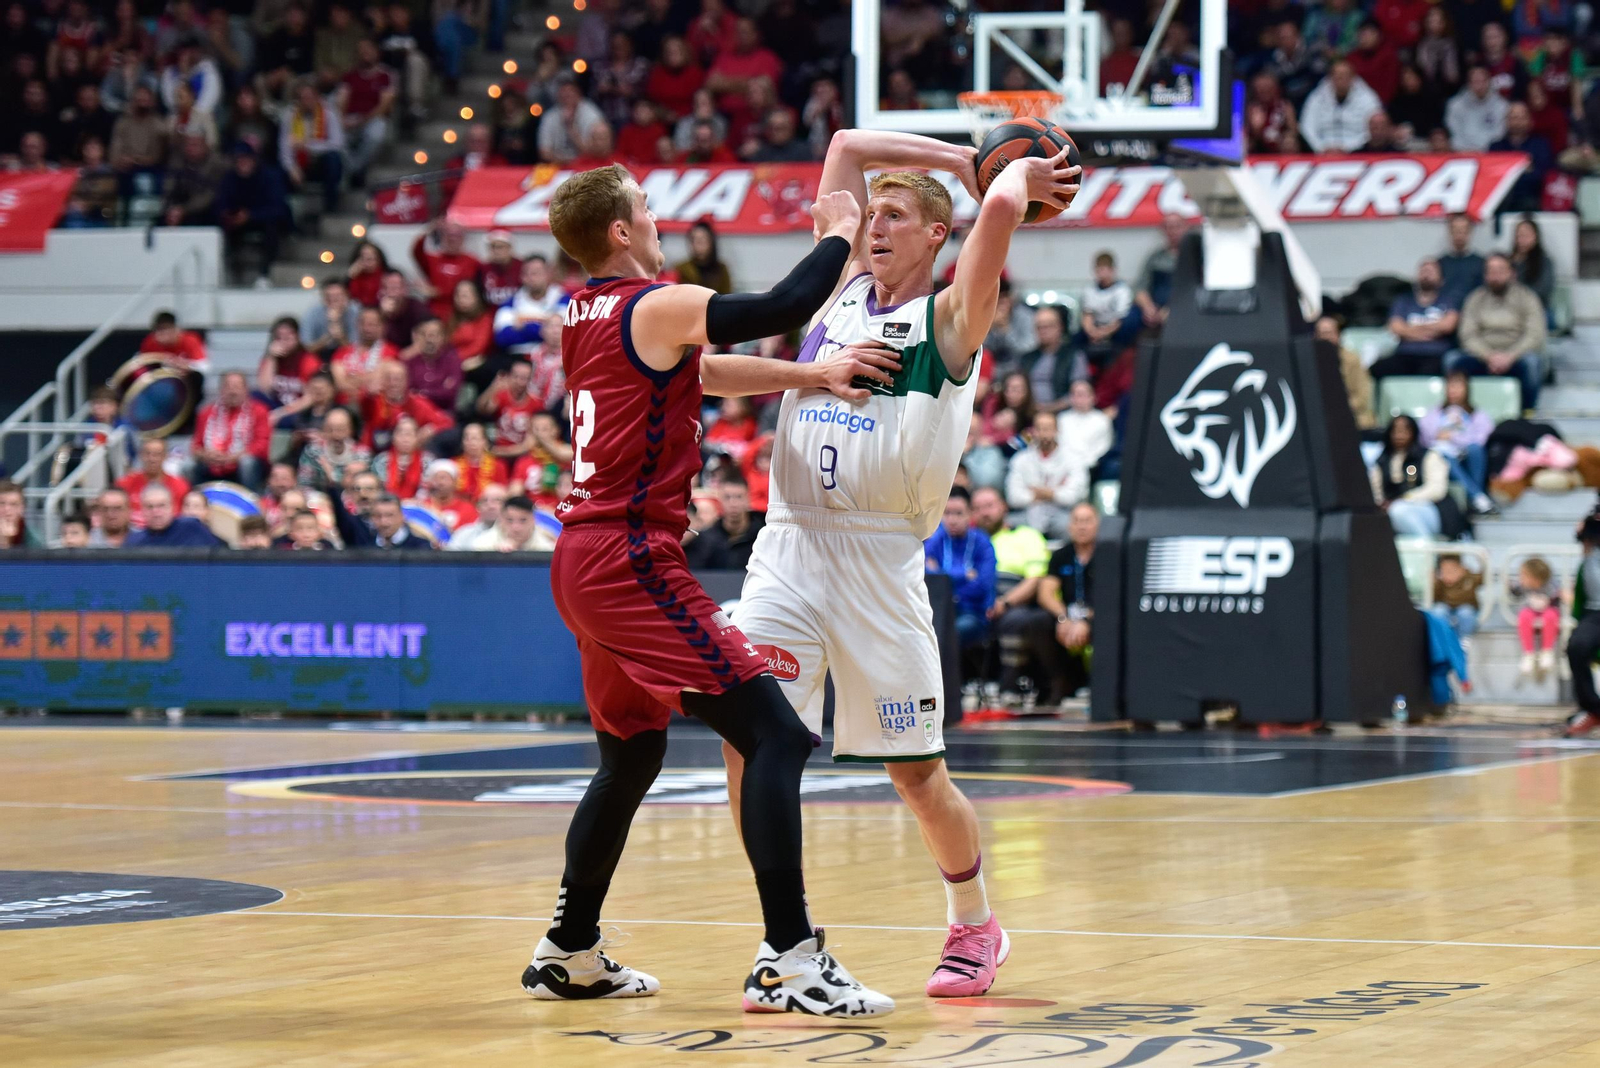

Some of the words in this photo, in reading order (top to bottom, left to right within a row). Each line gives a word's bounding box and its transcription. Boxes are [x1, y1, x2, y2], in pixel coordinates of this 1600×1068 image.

[799, 402, 876, 433] málaga
[569, 389, 596, 482] 2
[820, 444, 838, 490] 9
[571, 487, 591, 500] ento
[1143, 535, 1295, 594] ESP
[1139, 594, 1265, 614] SOLUTIONS
[225, 621, 428, 659] EXCELLENT
[874, 694, 893, 703] sabor
[882, 695, 917, 717] má
[921, 703, 934, 711] acb
[877, 712, 917, 734] laga
